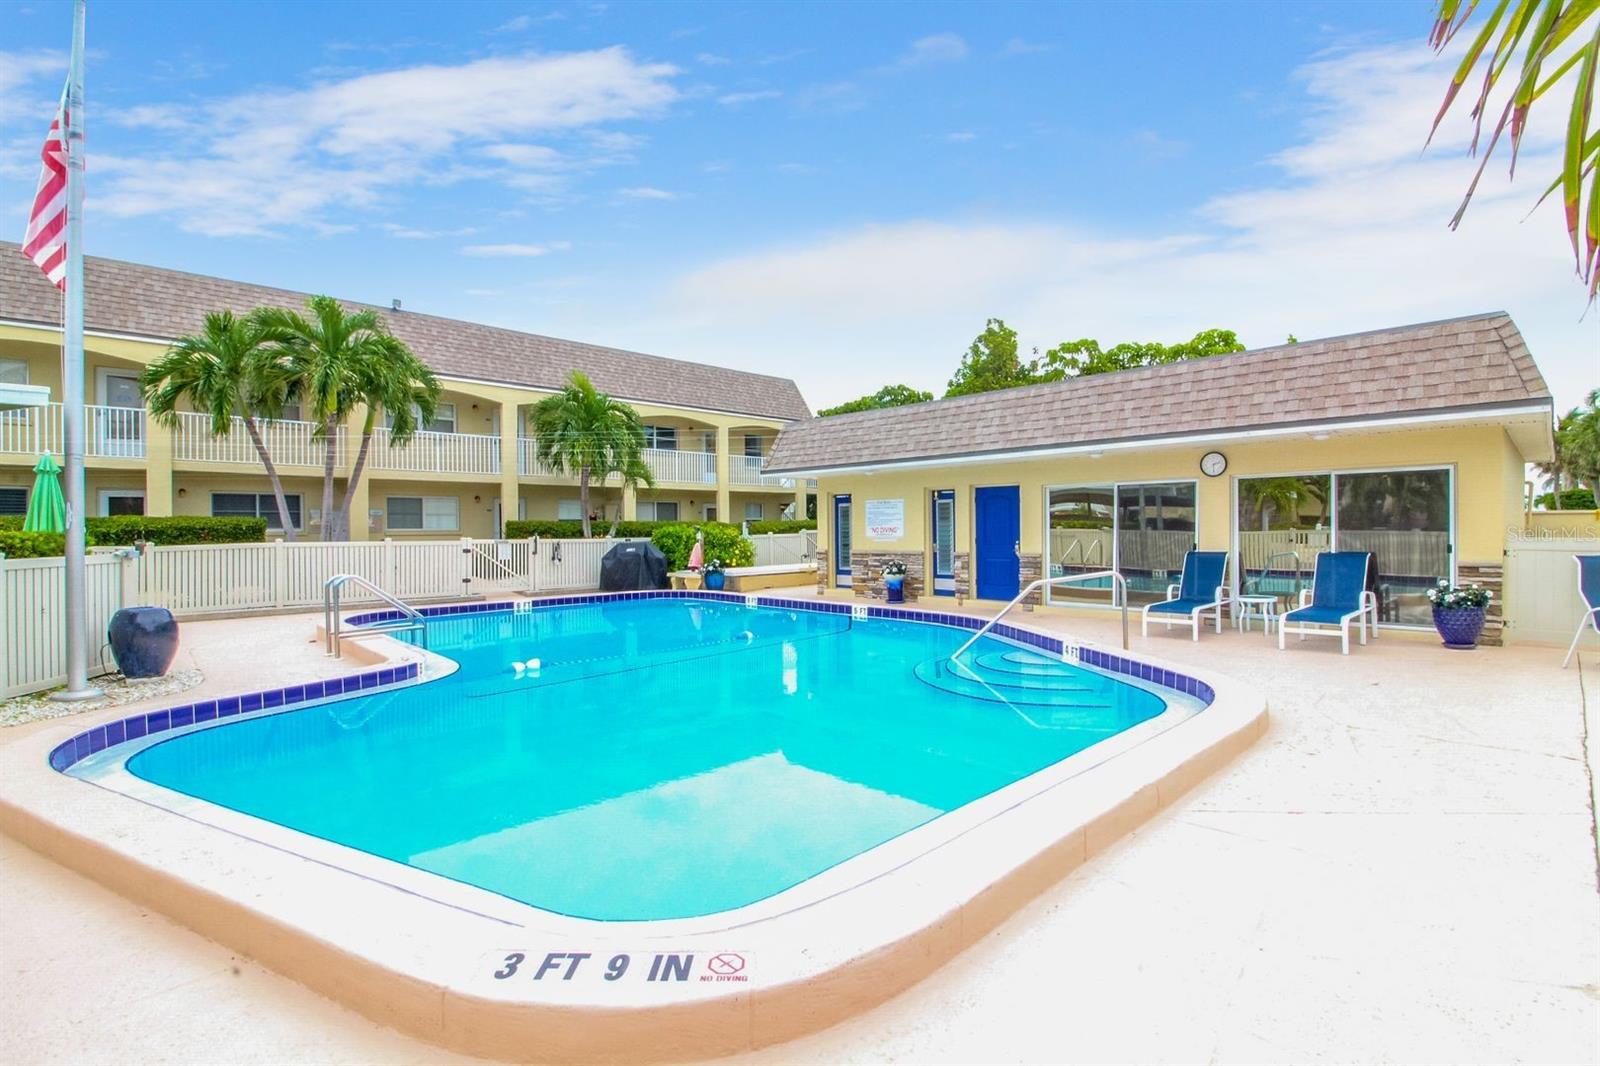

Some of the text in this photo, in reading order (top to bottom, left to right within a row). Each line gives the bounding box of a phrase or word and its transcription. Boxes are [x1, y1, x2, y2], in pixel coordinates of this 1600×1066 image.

[1071, 646, 1078, 658] FT
[494, 953, 694, 982] 3 FT 9 IN
